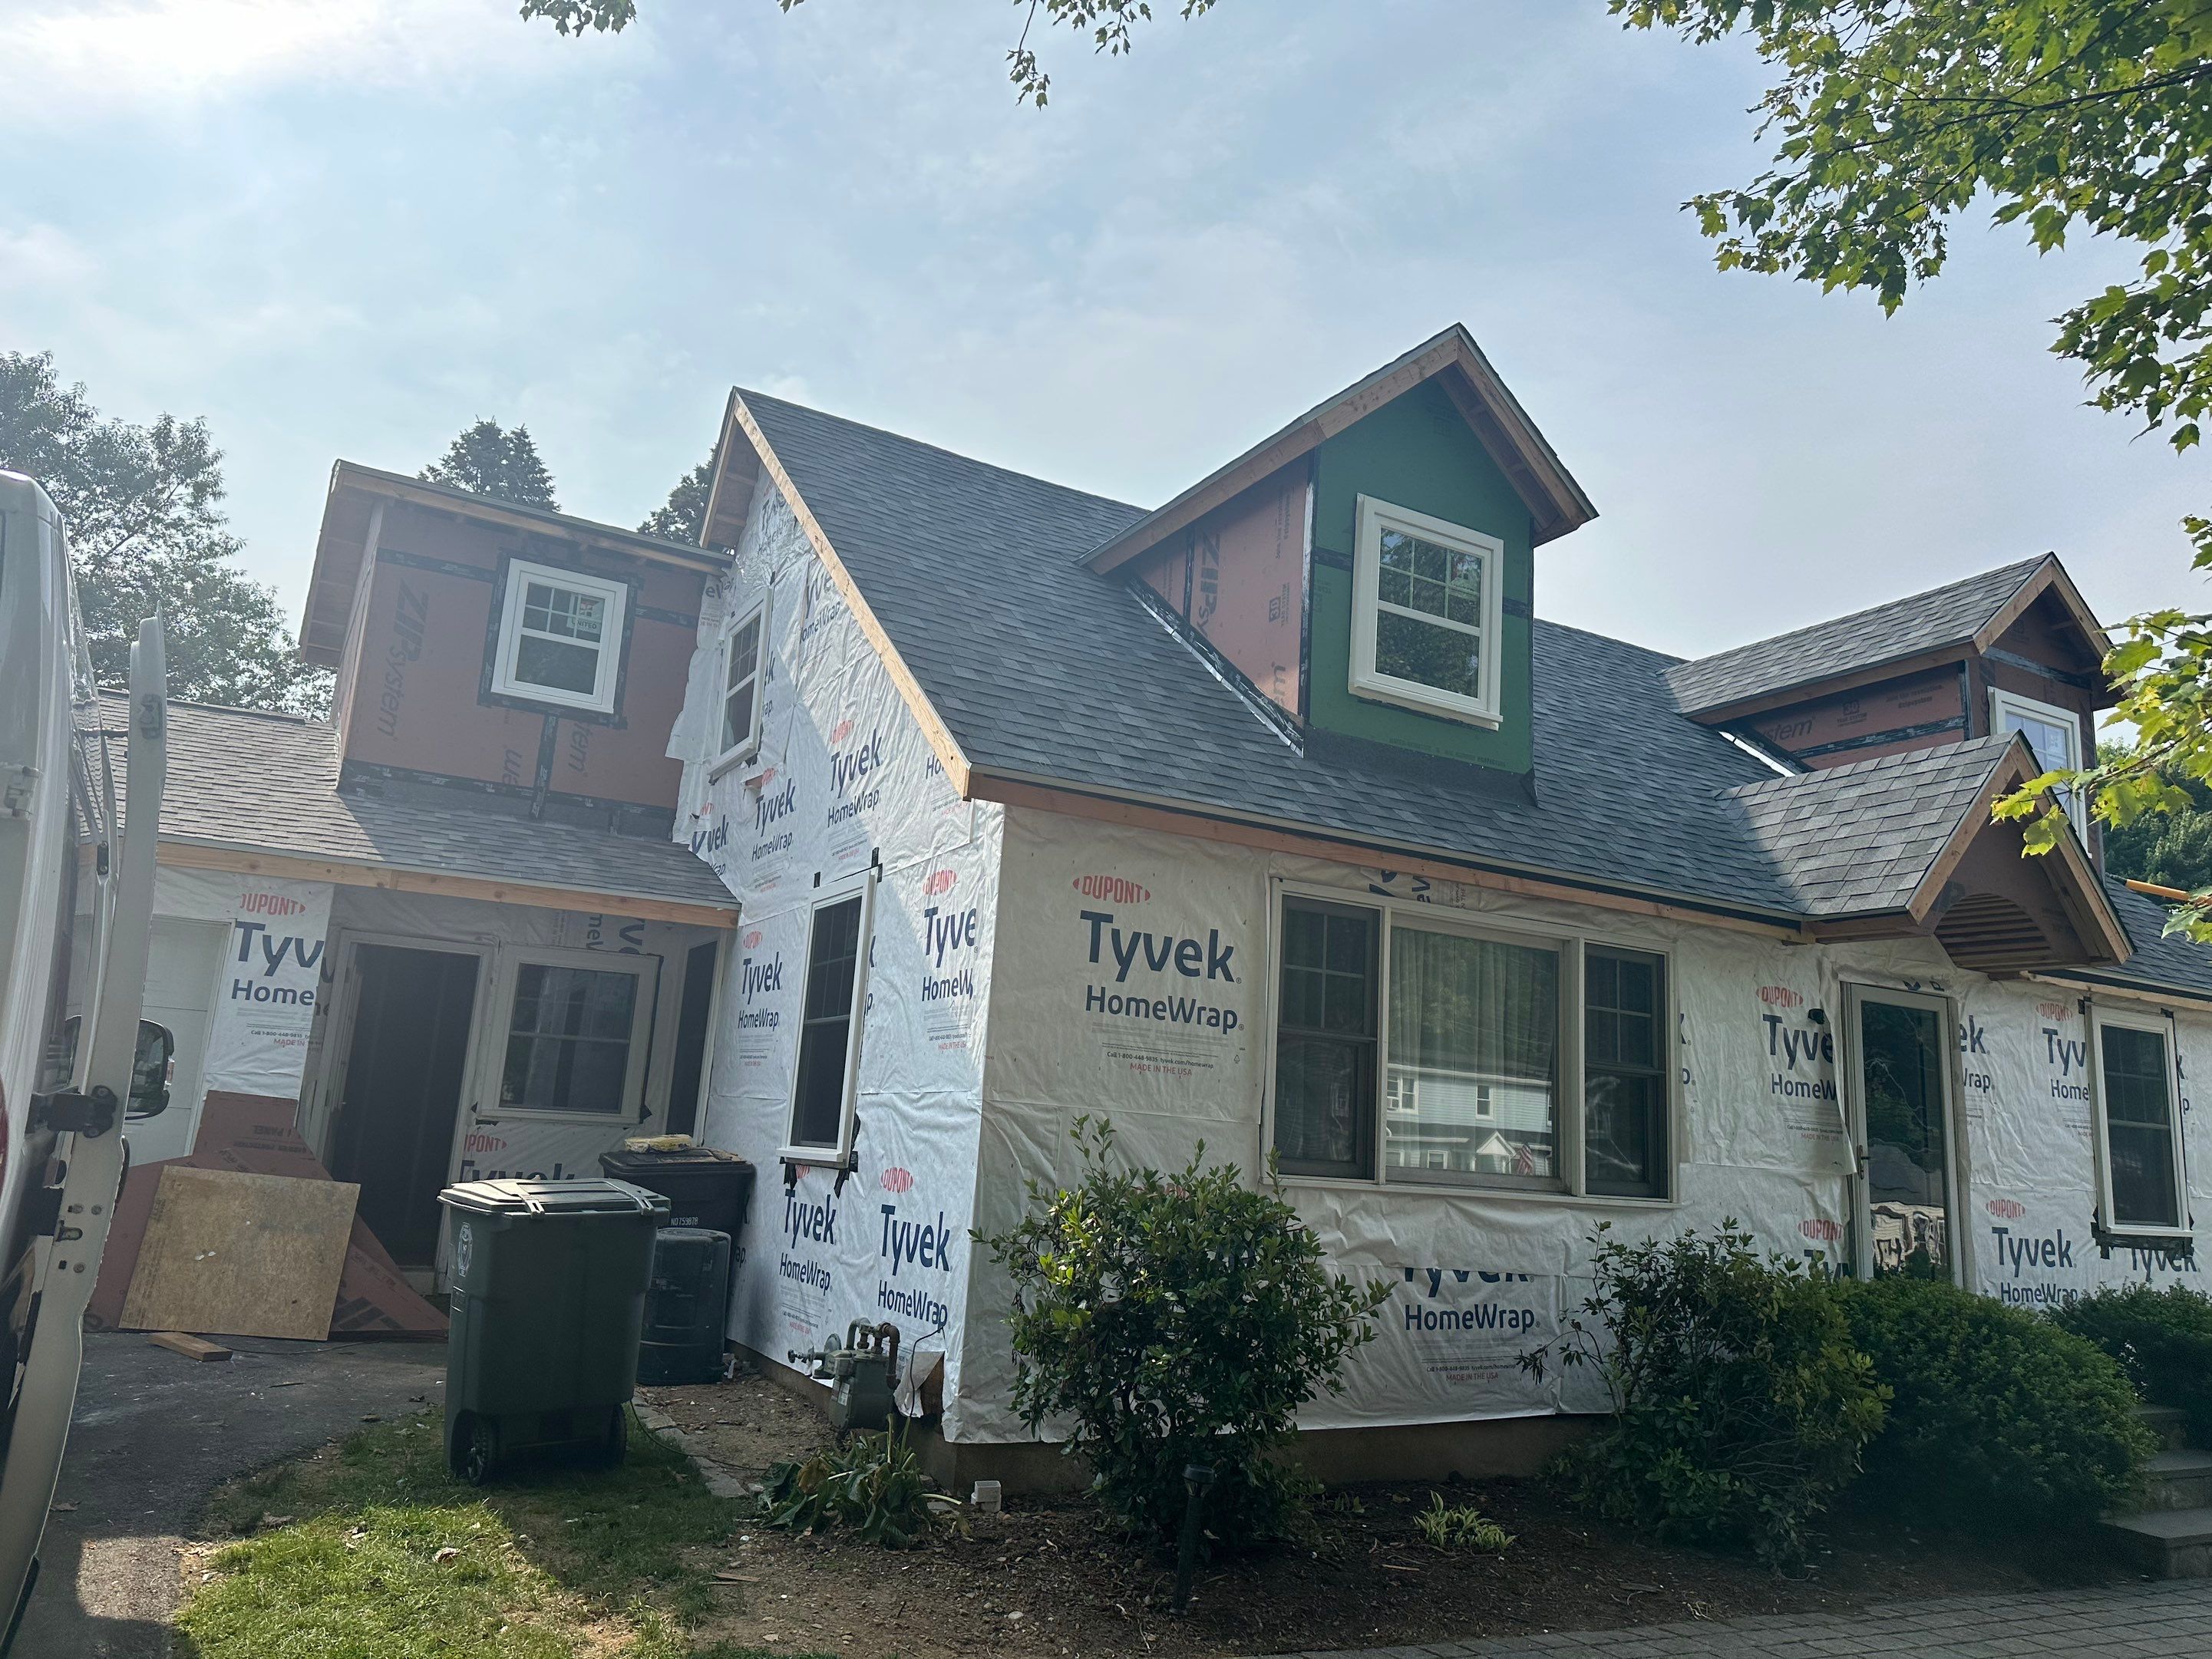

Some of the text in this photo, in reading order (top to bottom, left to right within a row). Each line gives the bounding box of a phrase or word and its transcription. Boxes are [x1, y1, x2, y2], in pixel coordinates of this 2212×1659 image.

[830, 727, 882, 800] Tyvek
[755, 777, 796, 838] Tyvek
[827, 788, 880, 829] HomeWrap
[751, 831, 793, 862] HomeWrap
[1081, 875, 1144, 904] DUPONT
[1079, 909, 1235, 983] Tyvek
[741, 951, 783, 1005] Tyvek
[1761, 985, 1798, 1008] DUPONT
[738, 1008, 779, 1031] HomeWrap
[1085, 984, 1238, 1035] HomeWrap
[1130, 1062, 1193, 1076] MADE IN THE USA
[784, 1188, 836, 1249] Tyvek
[1989, 1199, 2022, 1219] DUPONT
[880, 1203, 950, 1277] Tyvek
[1991, 1226, 2073, 1278] Tyvek
[778, 1252, 831, 1297] HomeWrap
[877, 1279, 949, 1334] HomeWrap
[1405, 1303, 1535, 1334] HomeWrap
